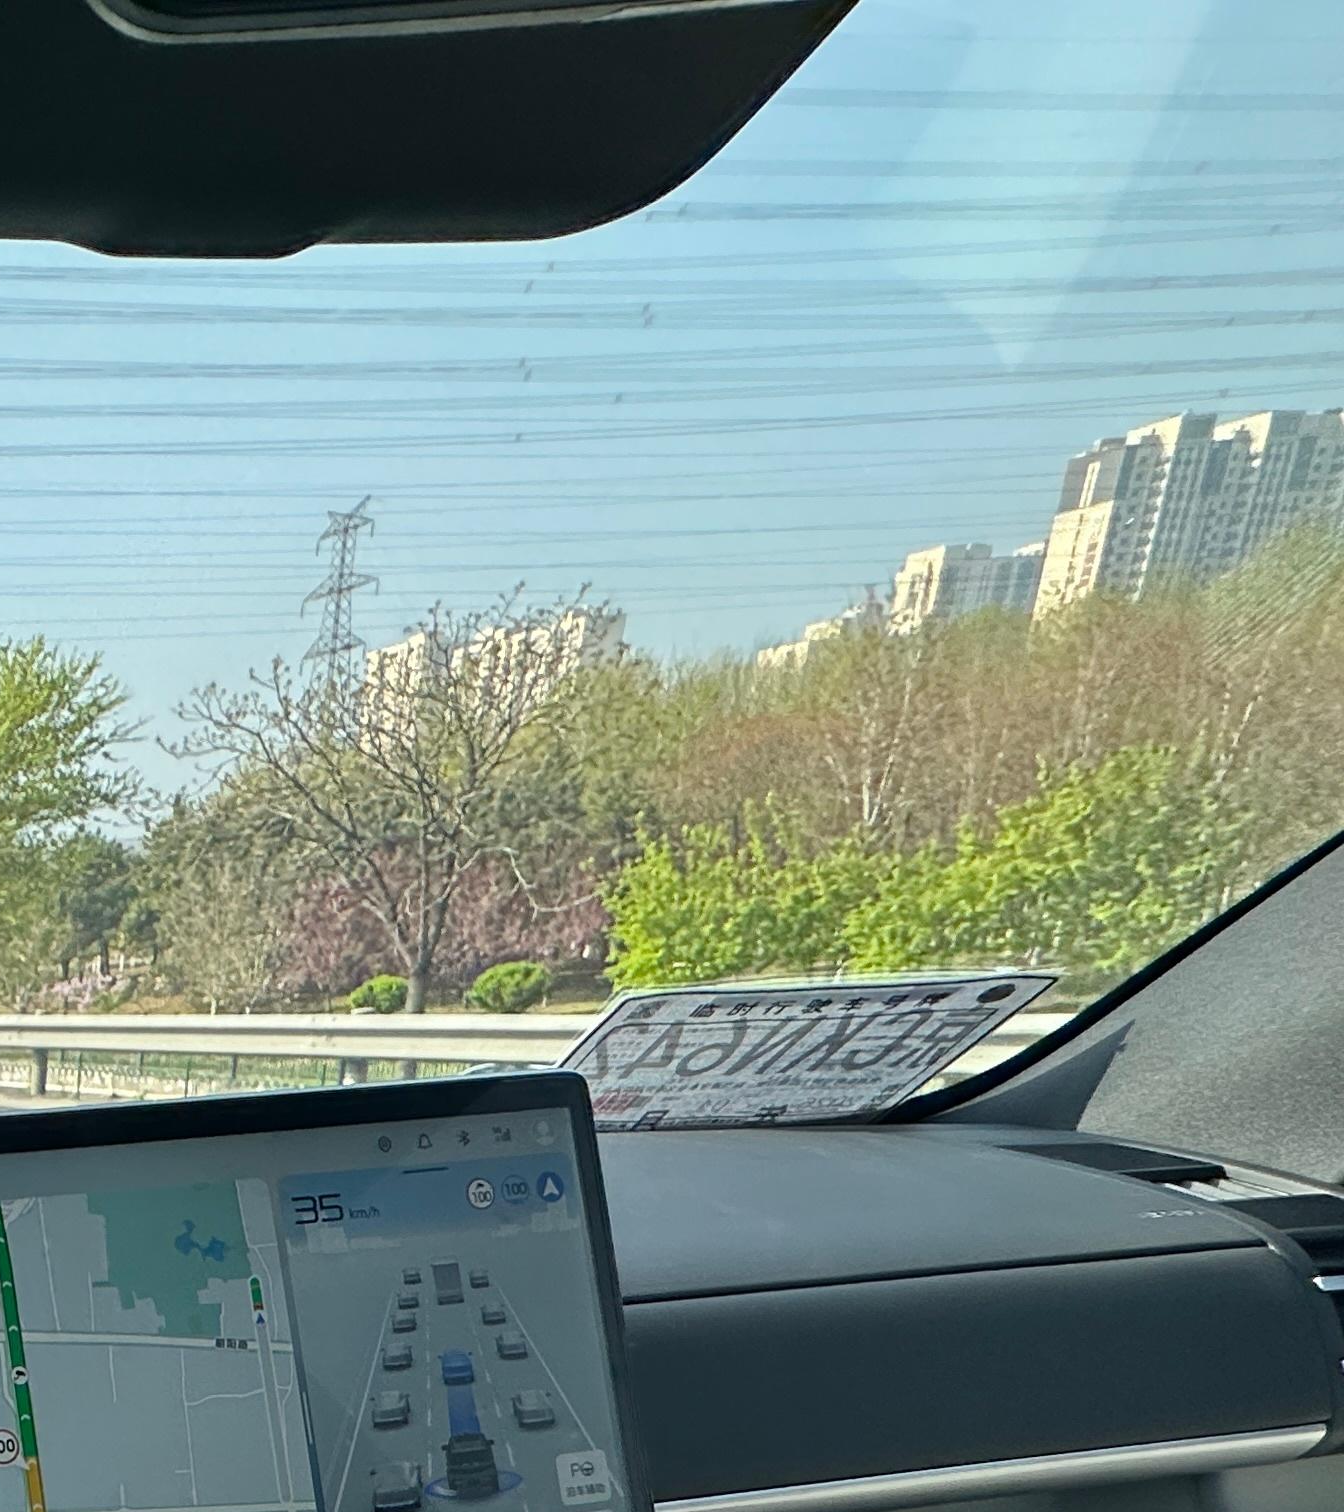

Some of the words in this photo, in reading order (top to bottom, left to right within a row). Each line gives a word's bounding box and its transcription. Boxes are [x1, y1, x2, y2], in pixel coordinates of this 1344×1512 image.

[689, 990, 954, 1018] 临时行驶车号牌
[471, 1189, 492, 1204] 100
[503, 1181, 527, 1196] 100
[290, 1193, 345, 1225] 35
[348, 1206, 381, 1220] km/h
